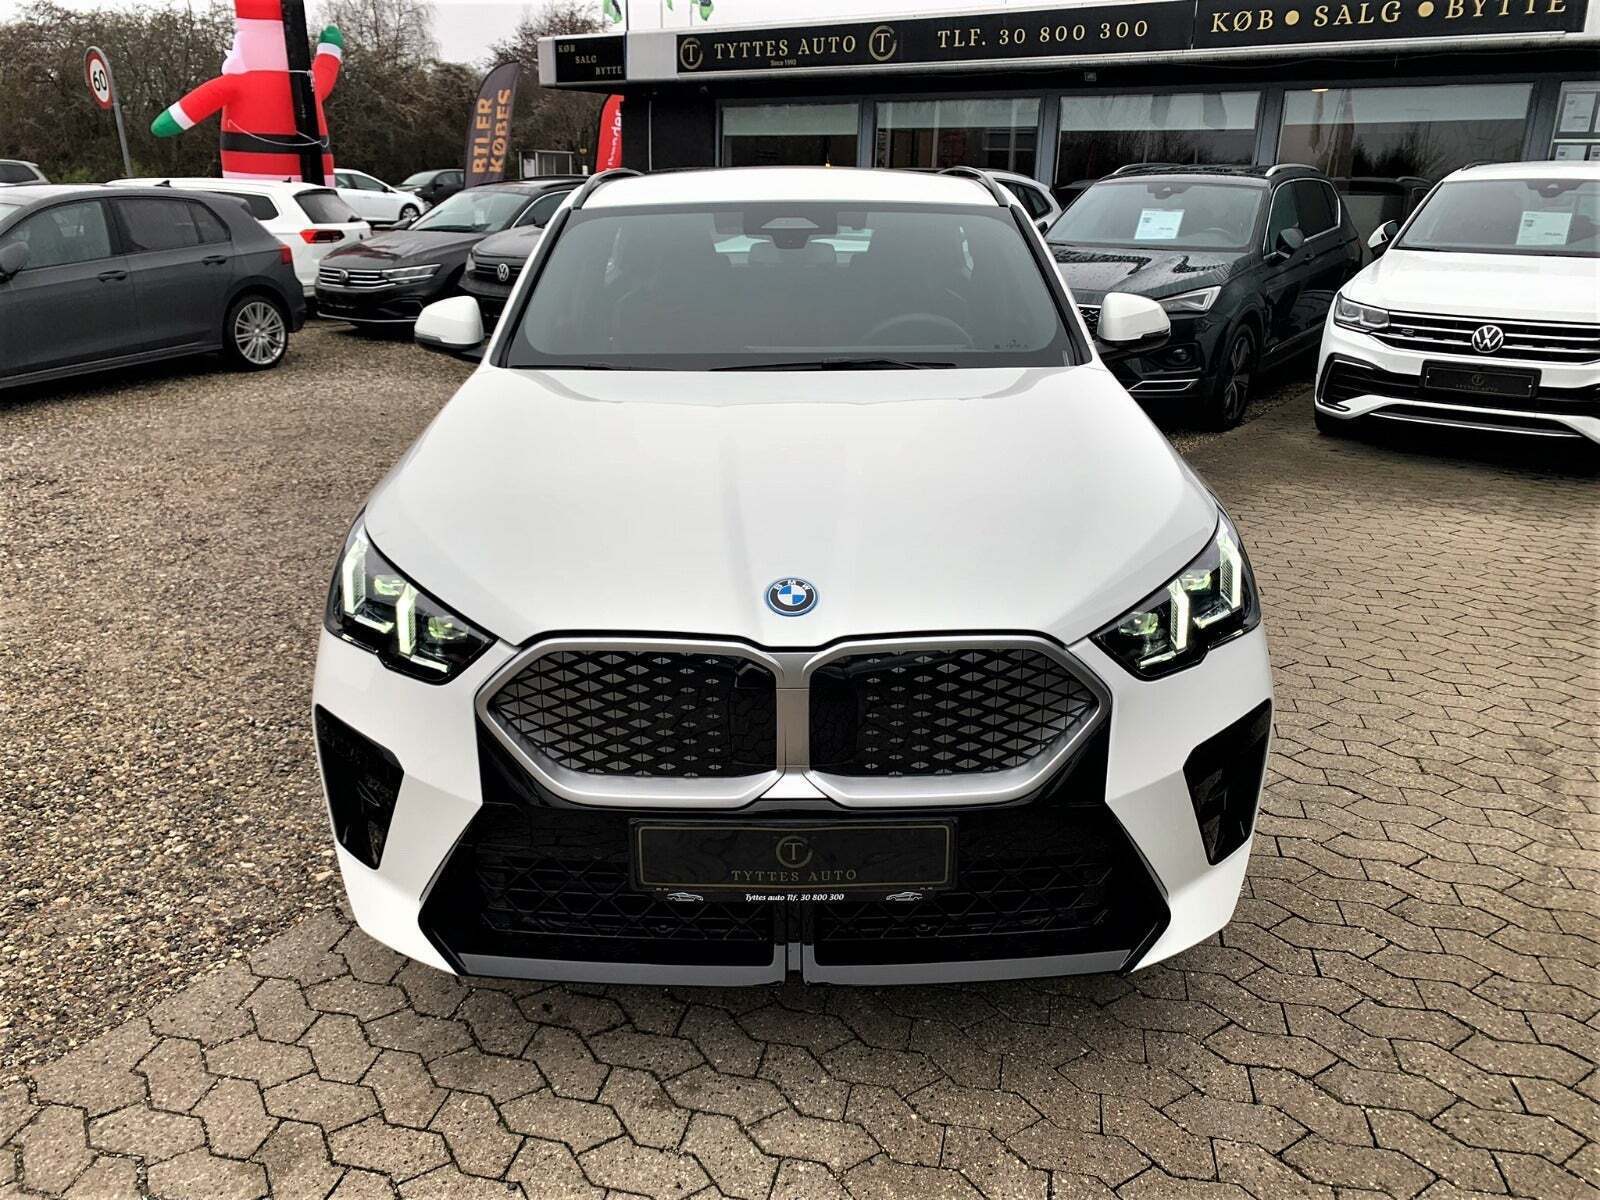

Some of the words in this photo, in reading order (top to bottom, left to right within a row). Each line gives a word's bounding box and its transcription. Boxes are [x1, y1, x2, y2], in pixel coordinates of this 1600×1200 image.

[1211, 9, 1275, 33] KØB
[1313, 0, 1402, 28] SALG
[937, 28, 987, 49] TLF.
[999, 28, 1026, 45] 30
[1039, 24, 1086, 43] 800
[1100, 20, 1148, 39] 300
[714, 39, 789, 60] TYTTES
[797, 35, 857, 55] AUTO
[93, 69, 107, 91] 60
[488, 89, 513, 173] KØBES
[731, 870, 800, 881] TYTTES
[807, 869, 857, 881] AUTO
[745, 893, 766, 902] Tyttes
[801, 893, 811, 901] 30
[812, 893, 828, 901] 800
[829, 893, 845, 901] 300
